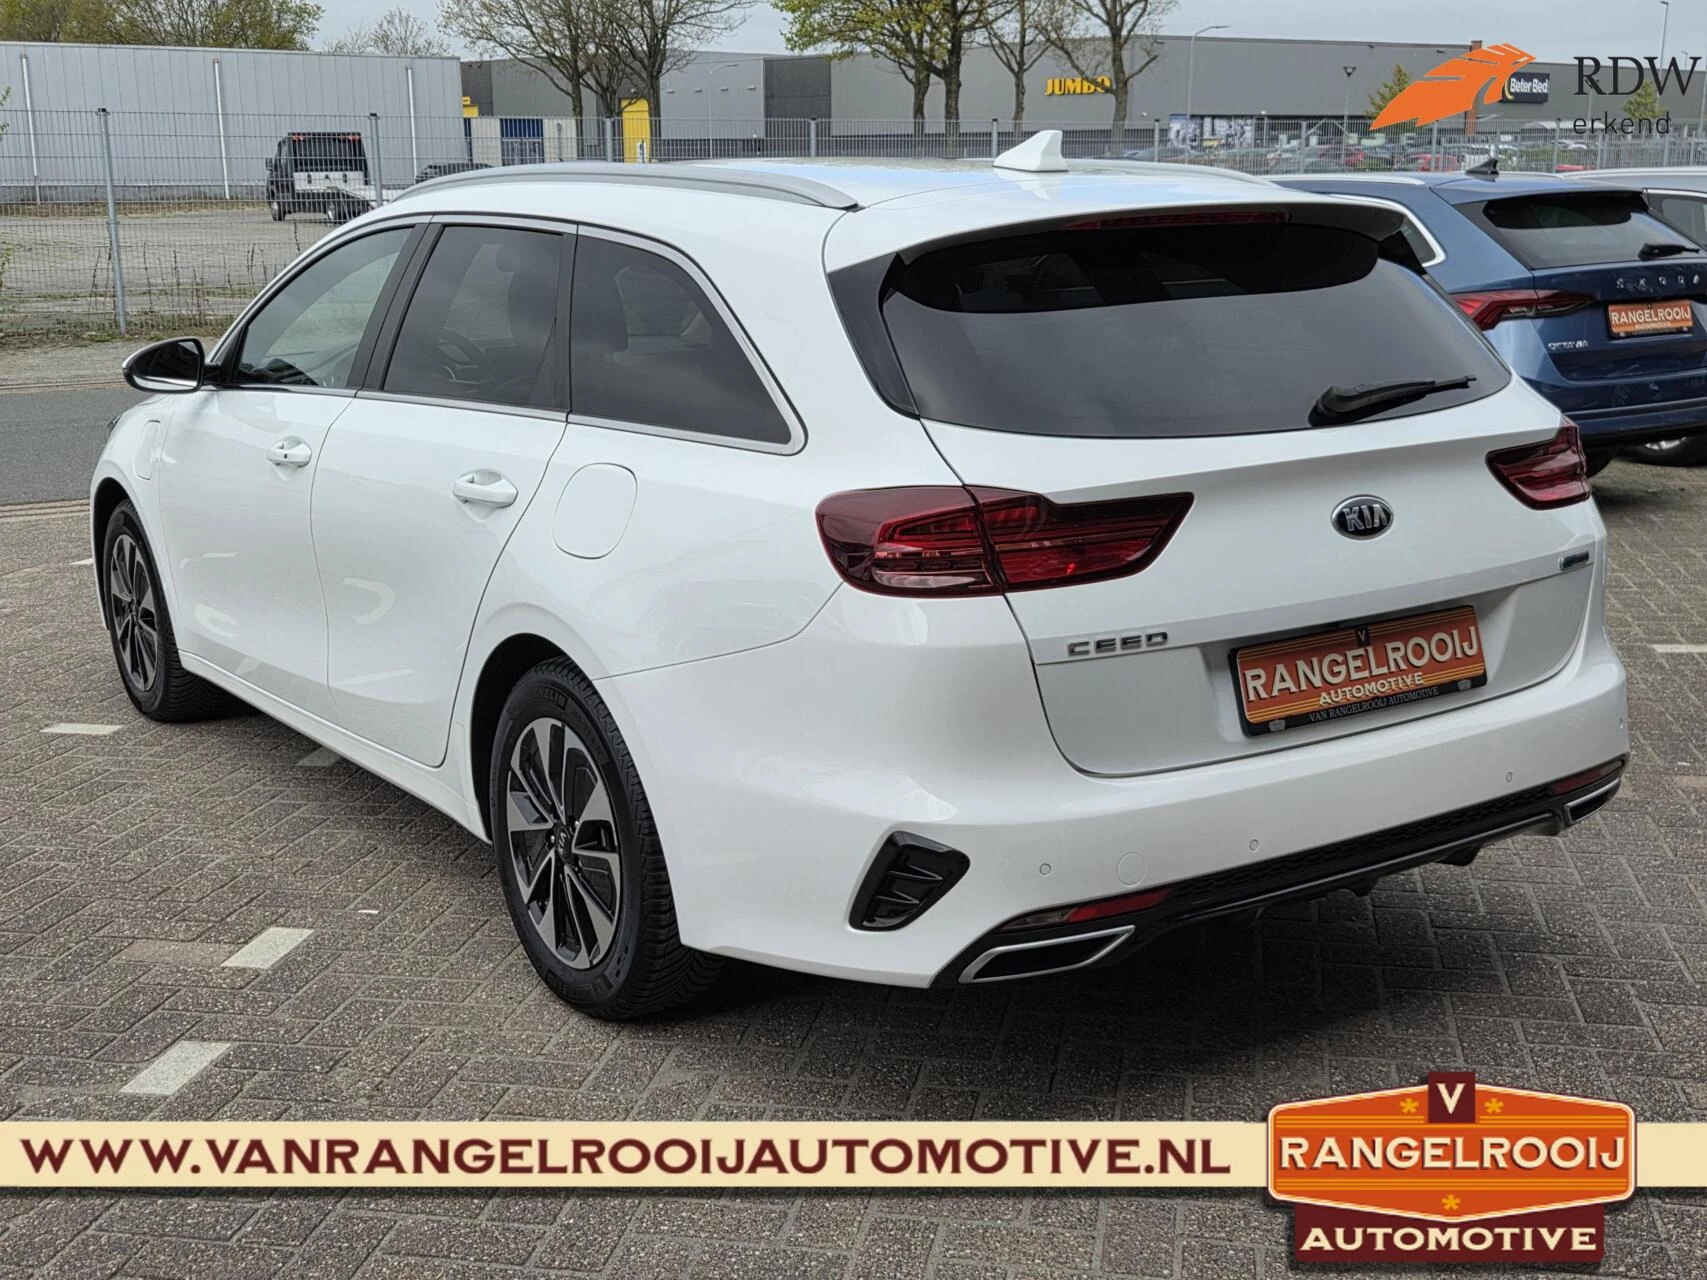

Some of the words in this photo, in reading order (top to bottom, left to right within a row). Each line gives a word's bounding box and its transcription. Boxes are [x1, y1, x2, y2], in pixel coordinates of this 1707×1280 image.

[1044, 76, 1111, 96] JUMBO
[1510, 77, 1532, 93] Beter
[1532, 78, 1548, 93] Bed
[1611, 306, 1691, 325] RANGELROOIJ
[1342, 503, 1388, 532] KIA
[1067, 631, 1168, 657] CEED
[1243, 626, 1479, 701] RANGELROOIJ
[1319, 672, 1424, 706] AUTOMOTIVE
[1309, 704, 1328, 722] VAN
[1329, 696, 1387, 718] RANGELROOIJ
[1387, 686, 1440, 706] AUTOMOTIVE
